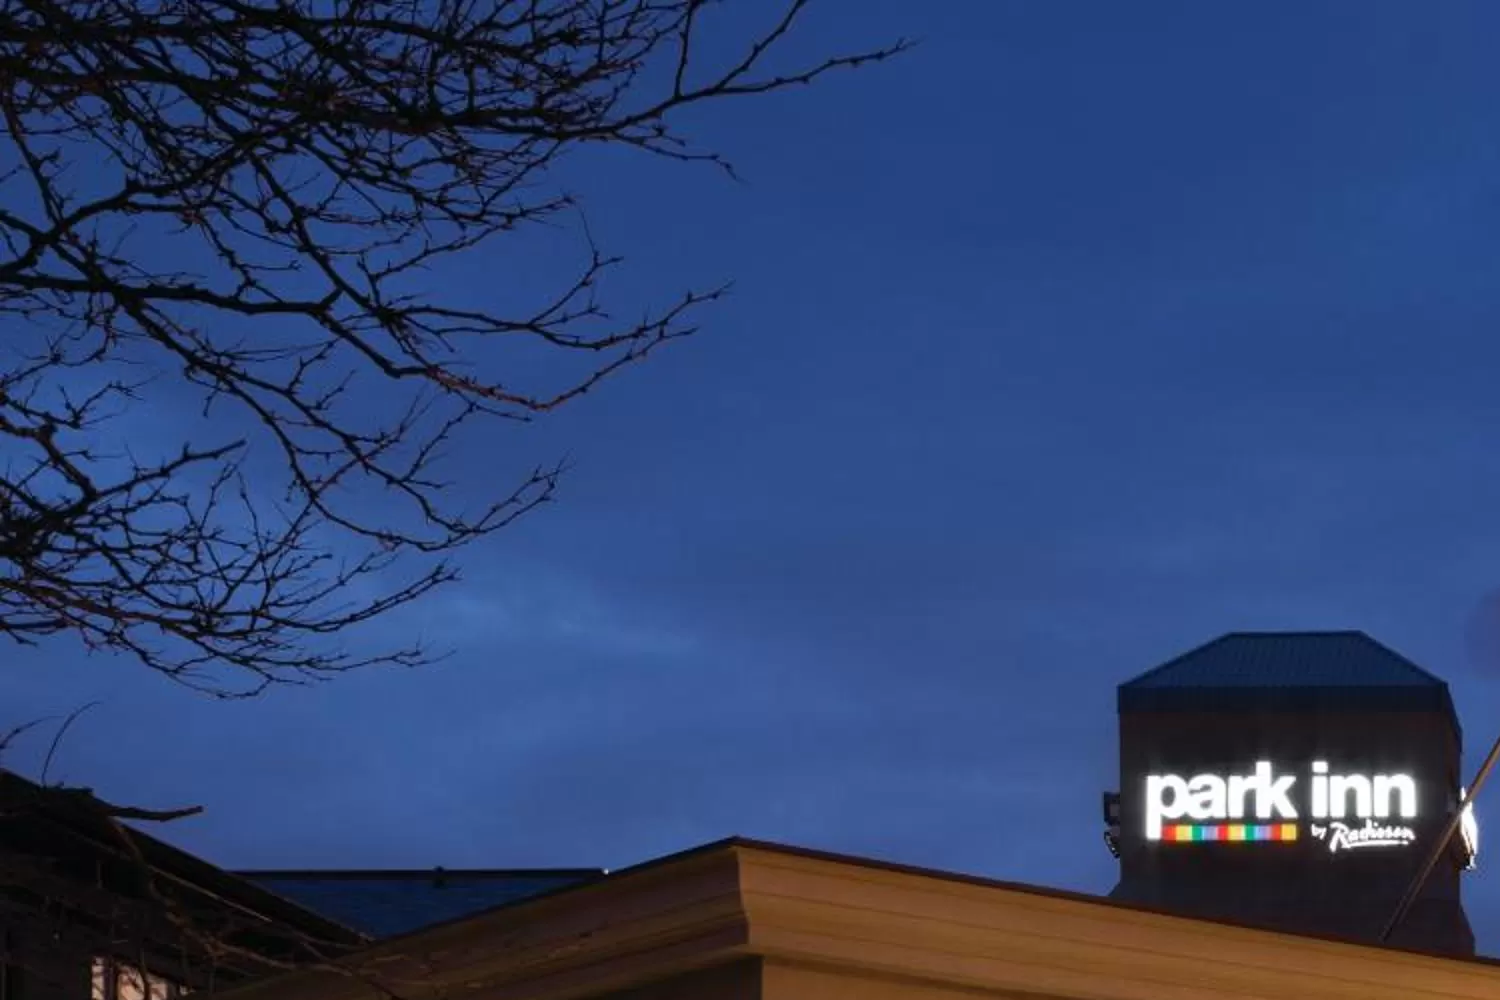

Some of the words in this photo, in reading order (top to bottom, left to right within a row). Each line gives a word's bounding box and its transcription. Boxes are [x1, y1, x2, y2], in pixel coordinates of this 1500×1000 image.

[1146, 761, 1298, 840] park
[1311, 761, 1416, 818] inn
[1311, 824, 1327, 840] by
